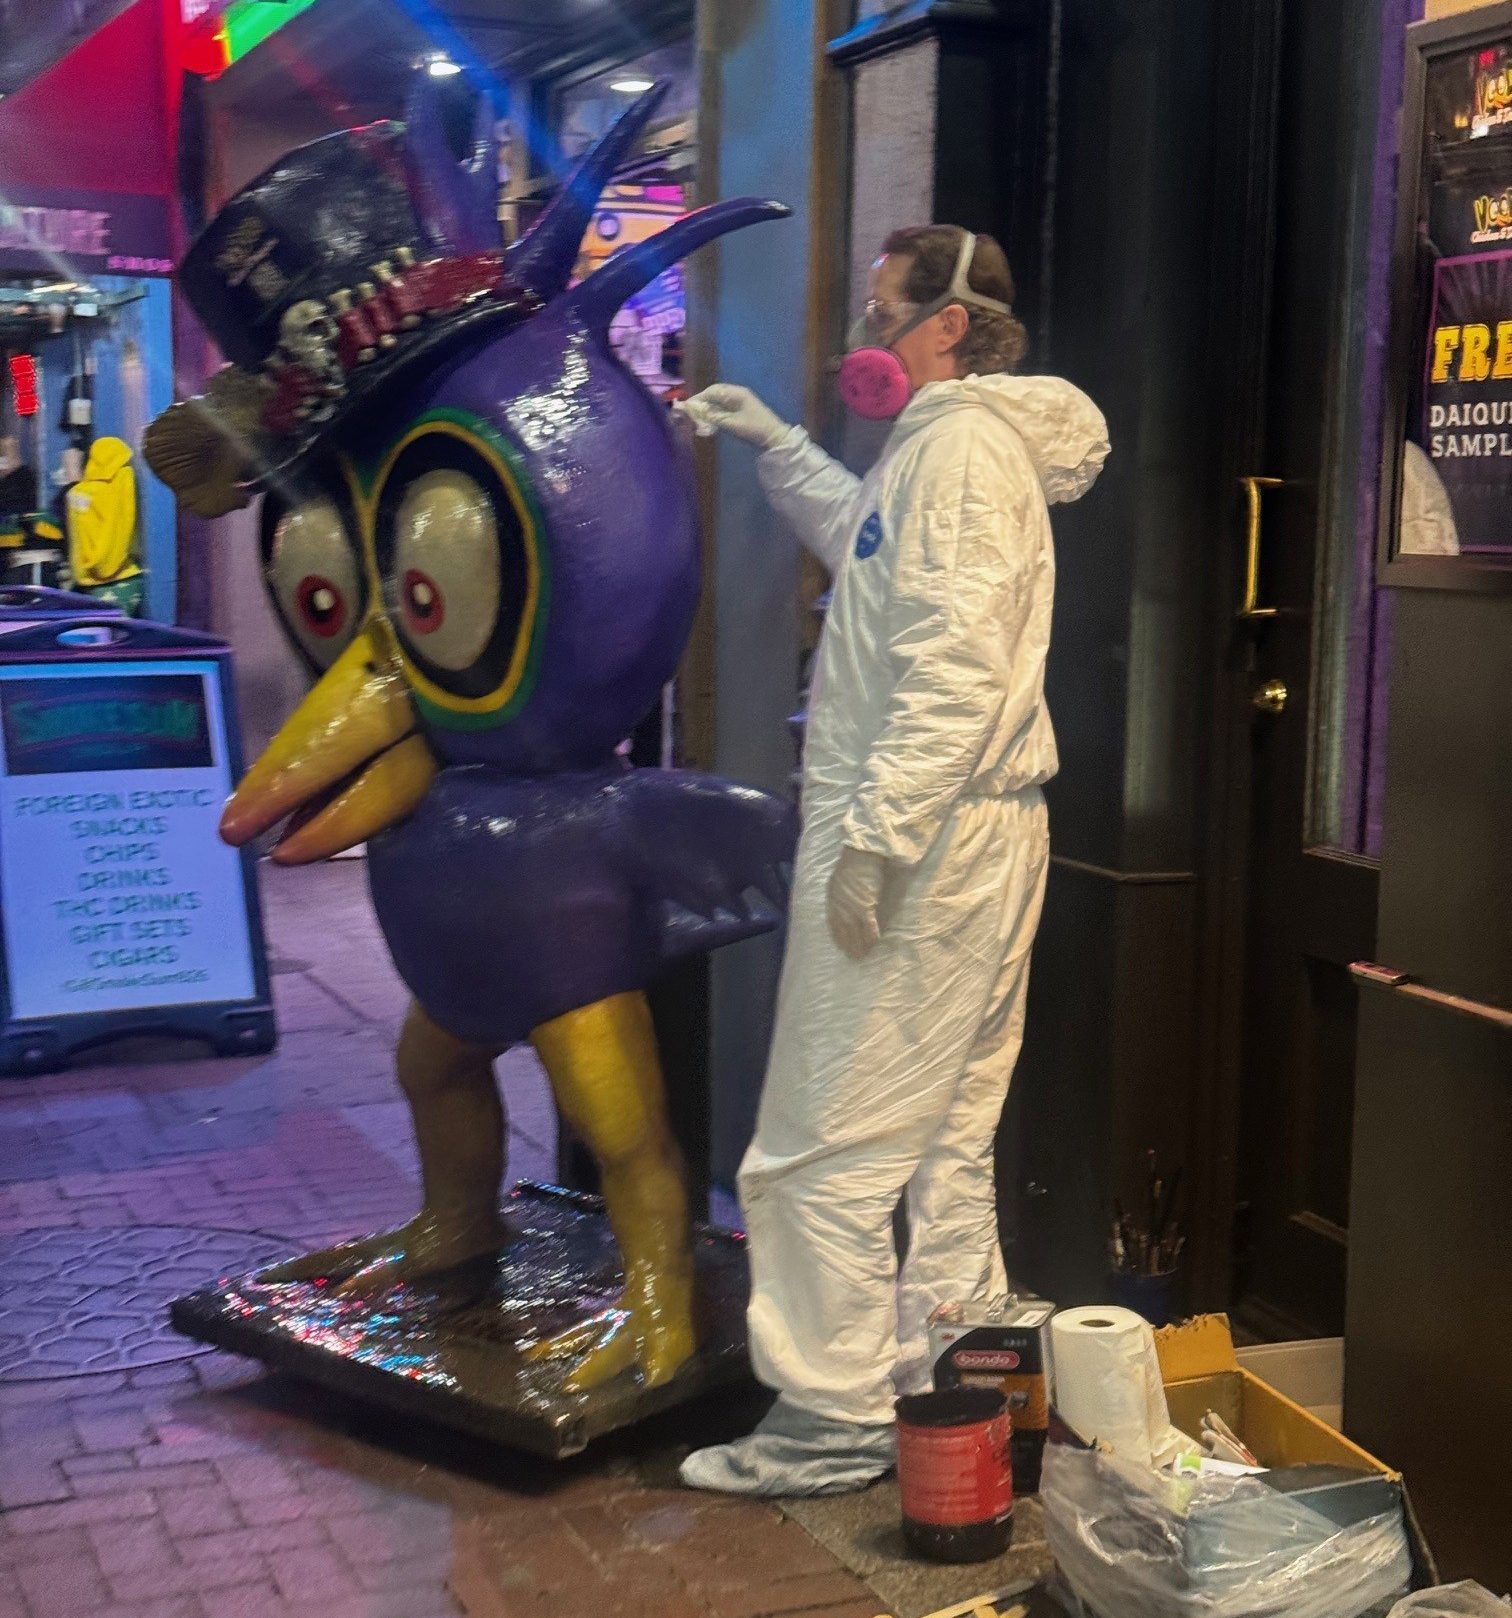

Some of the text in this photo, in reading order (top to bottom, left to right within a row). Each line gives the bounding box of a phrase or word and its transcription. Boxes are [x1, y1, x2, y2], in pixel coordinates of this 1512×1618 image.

[16, 789, 214, 817] FOREIGN EXOTIC
[69, 816, 168, 839] SNACKS
[85, 842, 160, 864] CHIPS
[78, 867, 172, 891] DRINKS
[52, 891, 202, 918] THC DRINKS
[69, 918, 192, 944] GIFT SETS
[88, 945, 178, 970] CIGARS
[959, 1353, 1010, 1366] bondo
